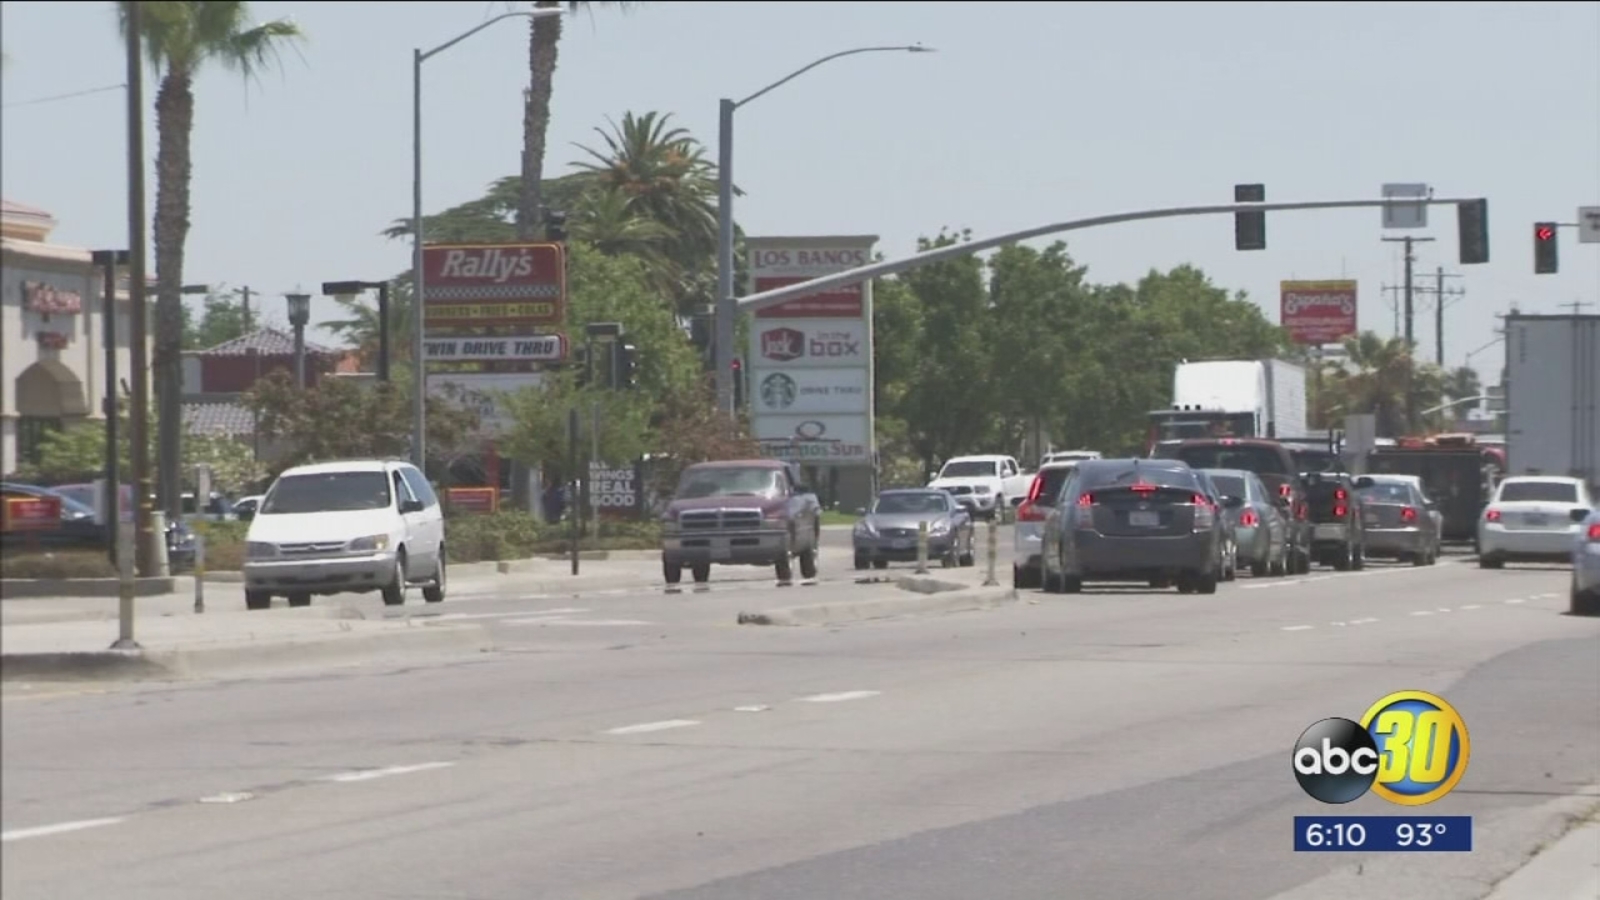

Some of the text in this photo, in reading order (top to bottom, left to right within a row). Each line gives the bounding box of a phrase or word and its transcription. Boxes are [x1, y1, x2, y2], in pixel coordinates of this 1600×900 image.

[440, 249, 533, 283] Rally's
[754, 250, 865, 268] LOS BANOS
[463, 342, 506, 355] DRIVE
[515, 341, 555, 355] THRU
[810, 339, 859, 357] box
[590, 481, 636, 494] REAL
[590, 495, 636, 507] GOOD
